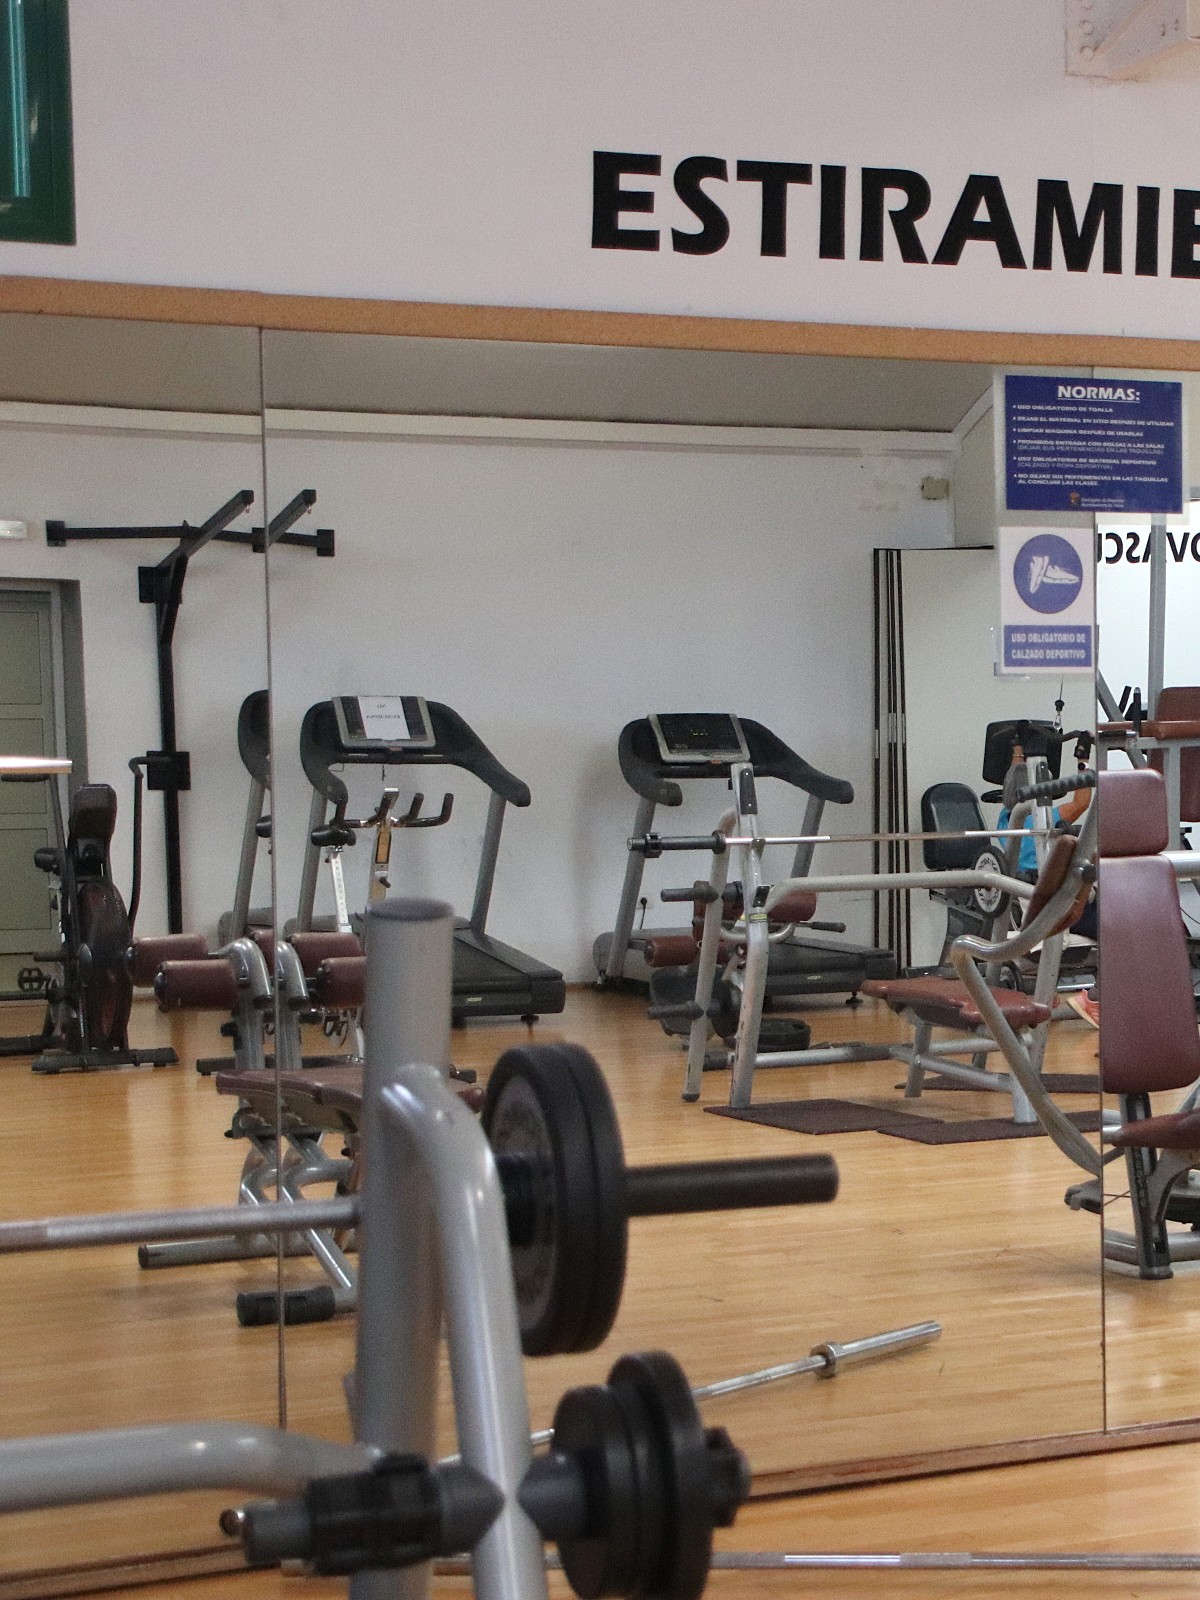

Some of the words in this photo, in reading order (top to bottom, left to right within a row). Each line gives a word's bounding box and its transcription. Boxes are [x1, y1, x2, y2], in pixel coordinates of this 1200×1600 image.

[1057, 385, 1141, 401] NORMAS:
[1011, 632, 1026, 643] USO
[1027, 632, 1075, 643] OBLIGATORIO
[1076, 633, 1086, 643] DE
[1011, 648, 1044, 659] CALZADO
[1045, 649, 1086, 660] DEPORTIVO
